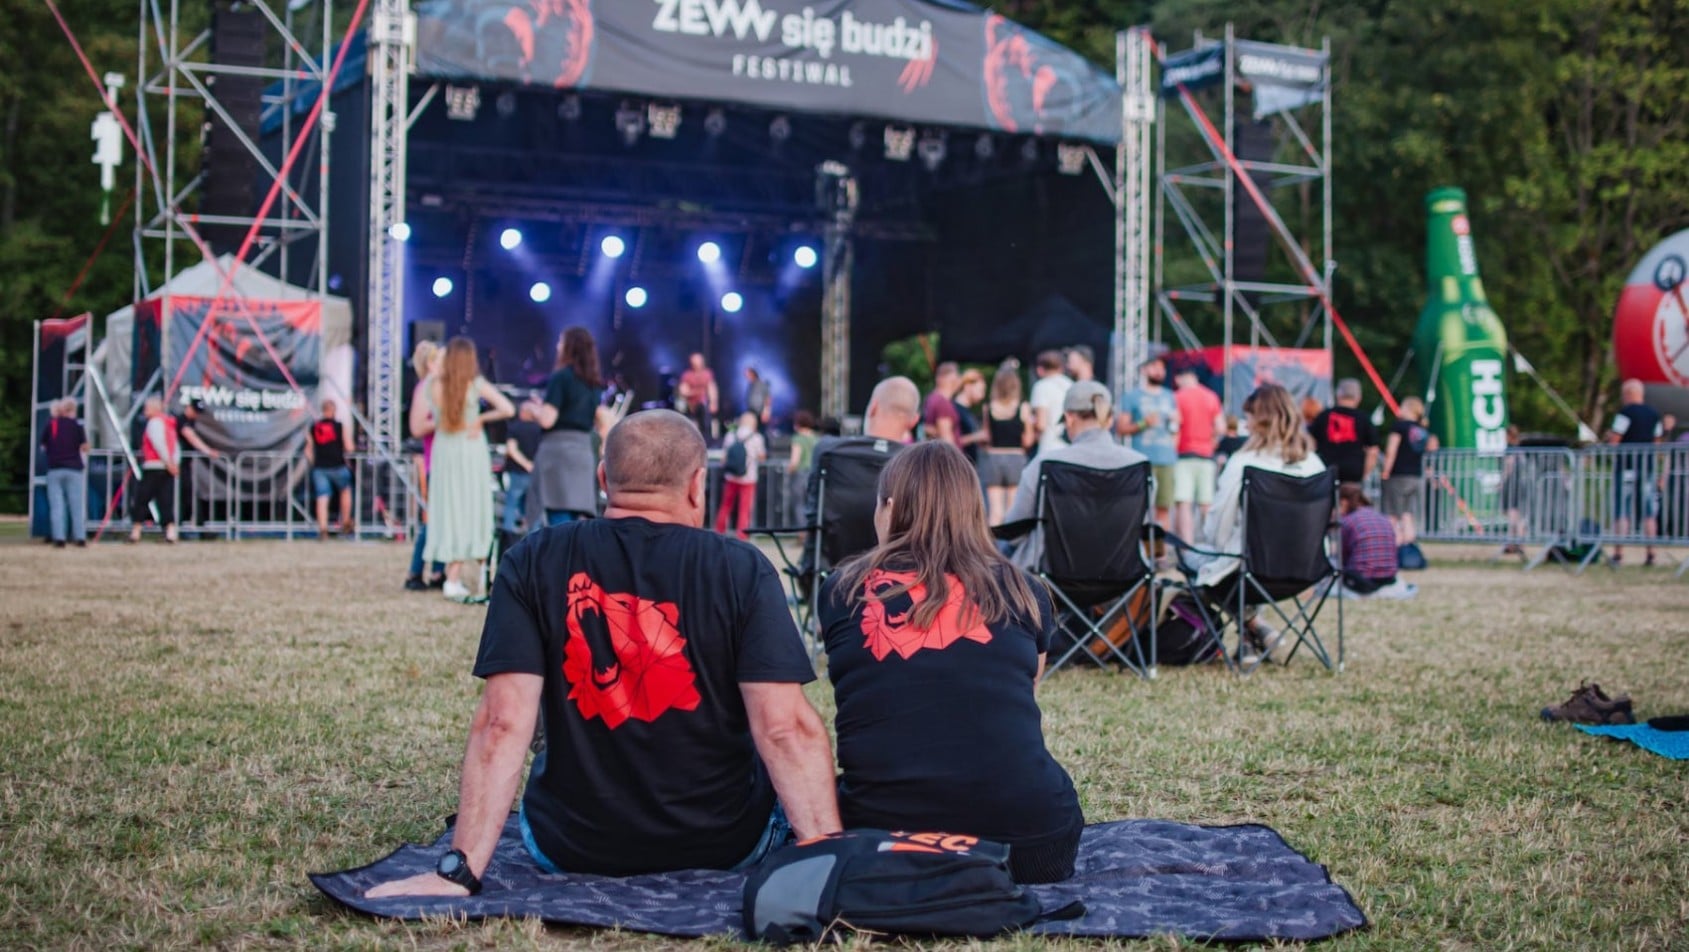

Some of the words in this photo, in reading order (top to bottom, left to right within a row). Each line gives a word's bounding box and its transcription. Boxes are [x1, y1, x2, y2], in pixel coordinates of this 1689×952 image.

[782, 7, 835, 58] się
[841, 10, 932, 60] budzi
[732, 54, 853, 87] FESTIWAL
